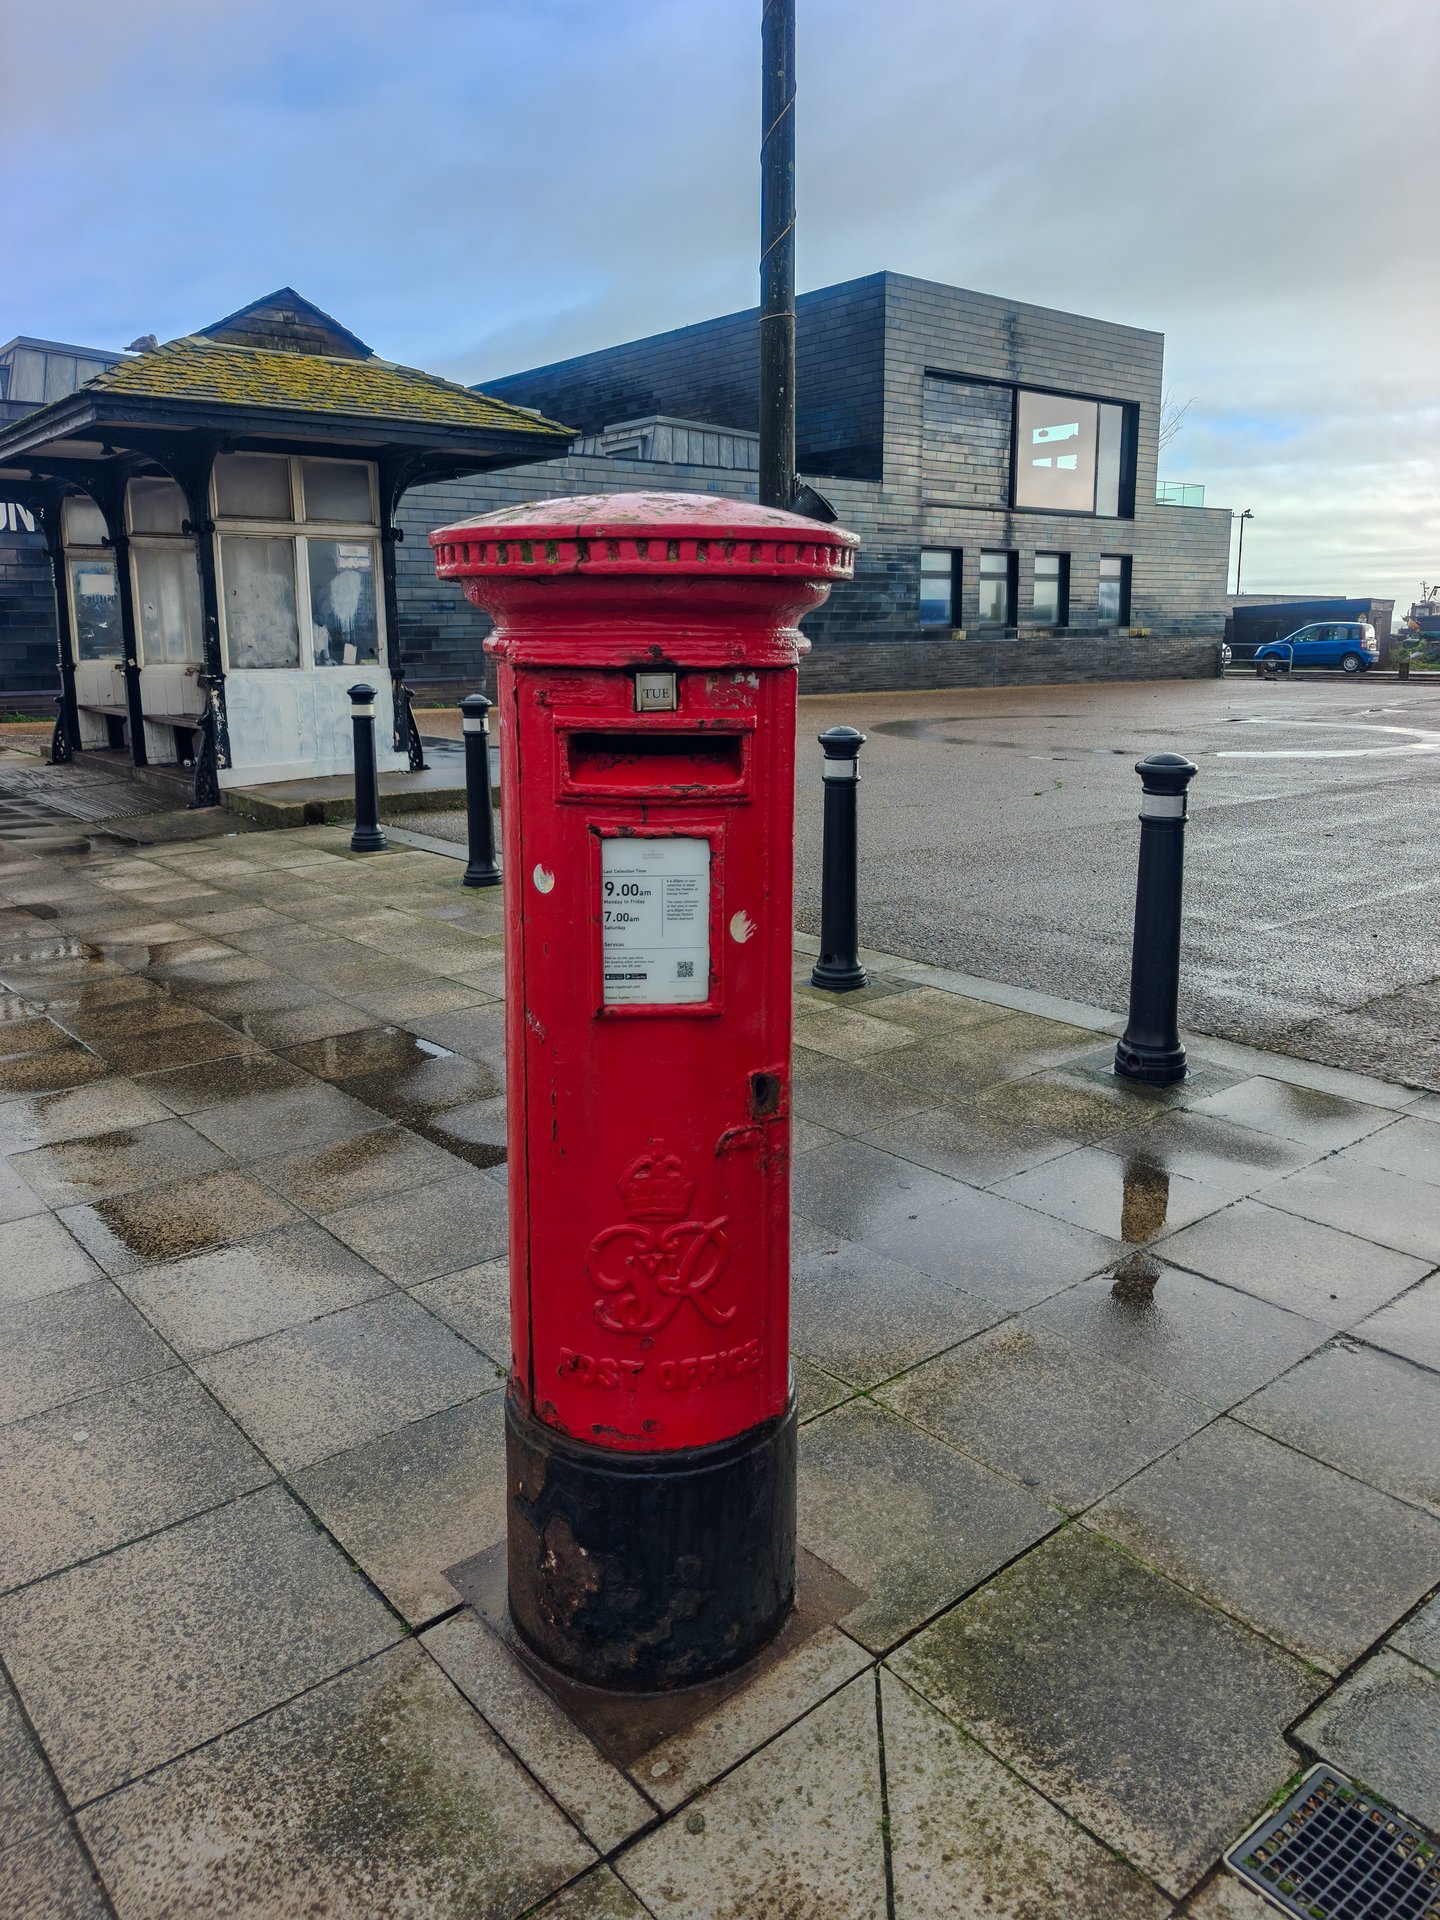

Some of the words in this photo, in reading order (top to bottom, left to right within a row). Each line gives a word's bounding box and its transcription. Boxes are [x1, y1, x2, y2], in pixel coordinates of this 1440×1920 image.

[643, 688, 670, 699] TUE
[604, 881, 651, 897] 9.00am
[604, 911, 640, 922] 7.00am
[557, 1346, 645, 1393] POST
[656, 1338, 761, 1392] OFFICE
